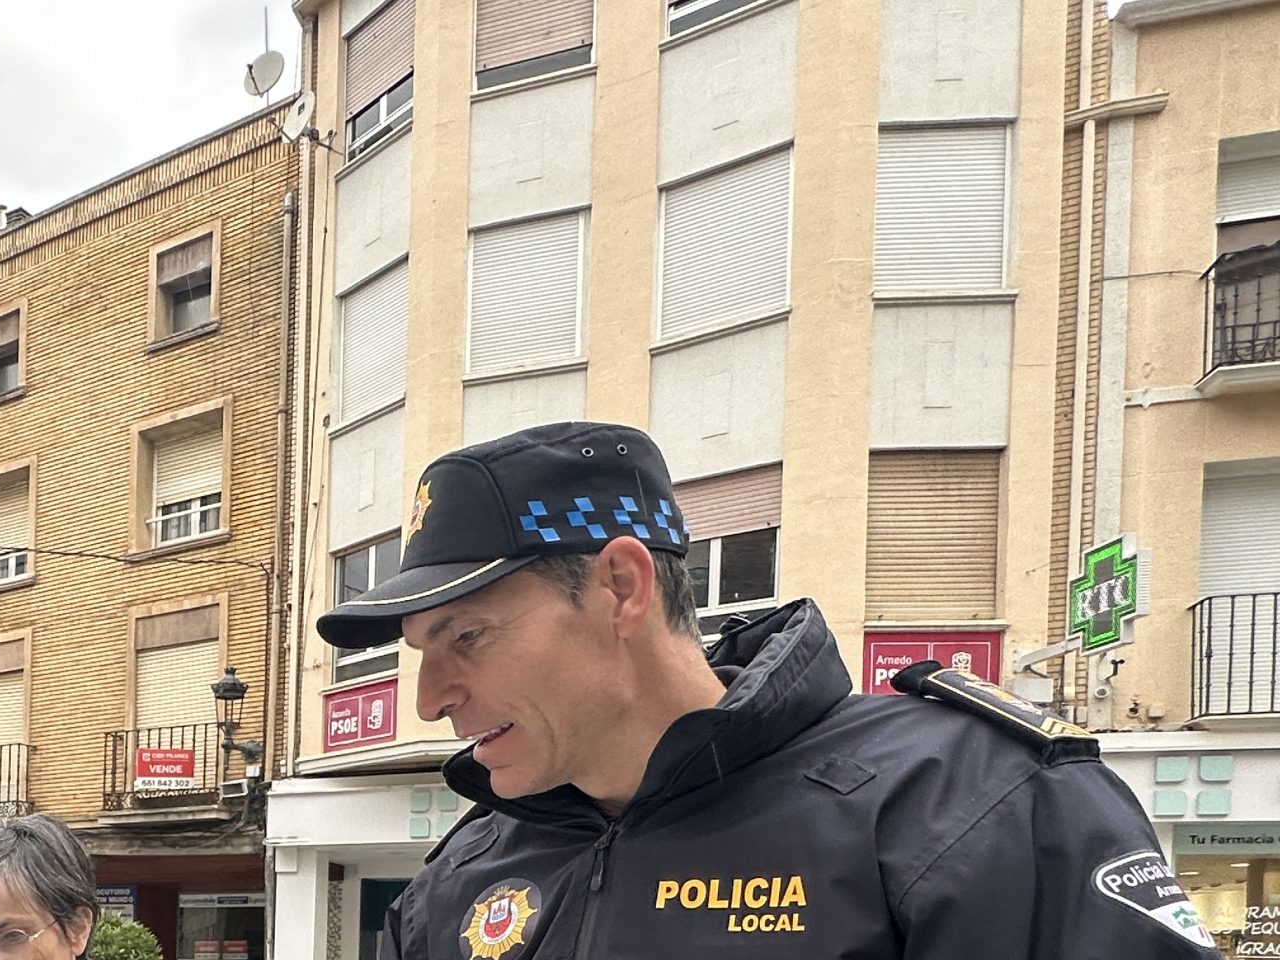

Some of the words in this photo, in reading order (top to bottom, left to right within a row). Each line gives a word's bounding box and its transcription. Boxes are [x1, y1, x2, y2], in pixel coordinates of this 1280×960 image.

[876, 655, 912, 666] Arnedo
[331, 716, 358, 736] PSOE
[149, 765, 183, 774] VENDE
[1189, 834, 1206, 844] Tu
[95, 888, 131, 896] OCUTORIO
[655, 876, 807, 910] POLICIA
[727, 913, 806, 932] LOCAL
